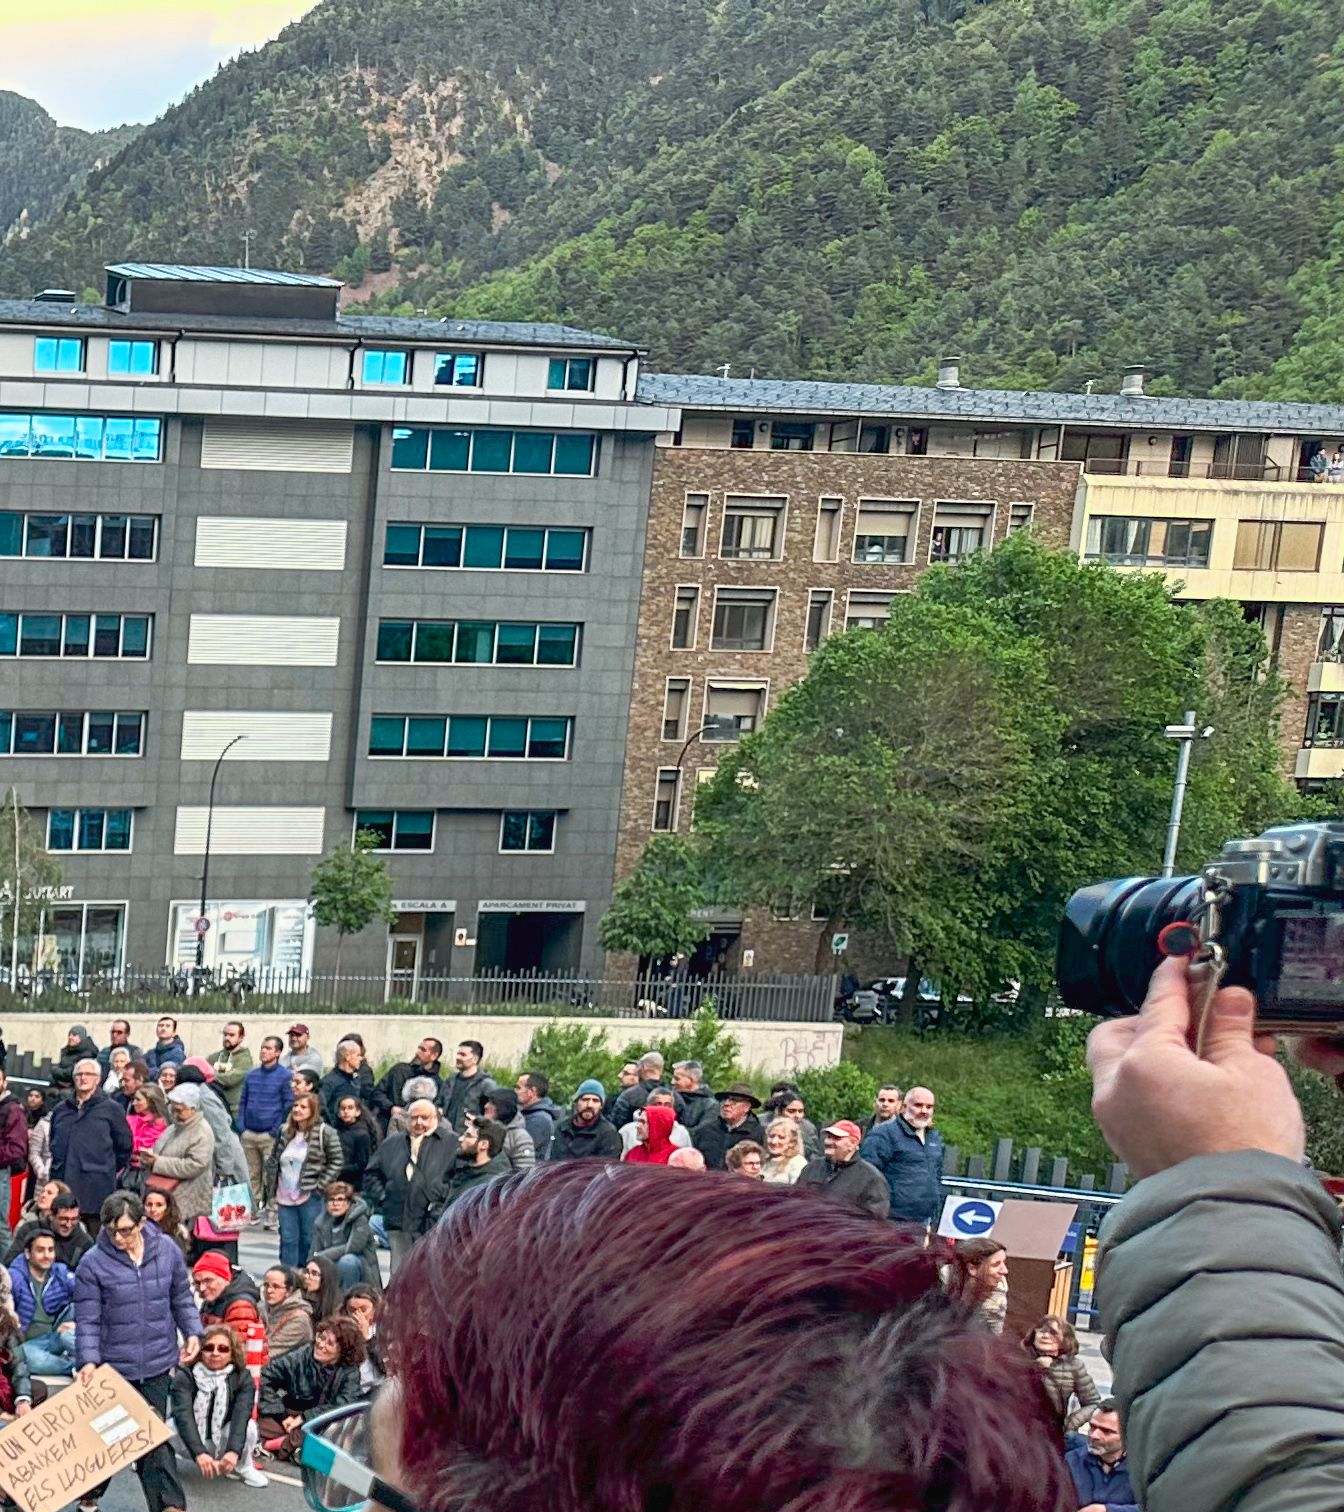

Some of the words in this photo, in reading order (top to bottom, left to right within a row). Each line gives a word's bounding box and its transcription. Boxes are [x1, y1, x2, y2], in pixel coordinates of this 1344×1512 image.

[4, 1435, 26, 1461] UN
[8, 1433, 77, 1488] ABAIXEM
[24, 1480, 54, 1512] ELS
[57, 1420, 154, 1490] LLOGUERS!
